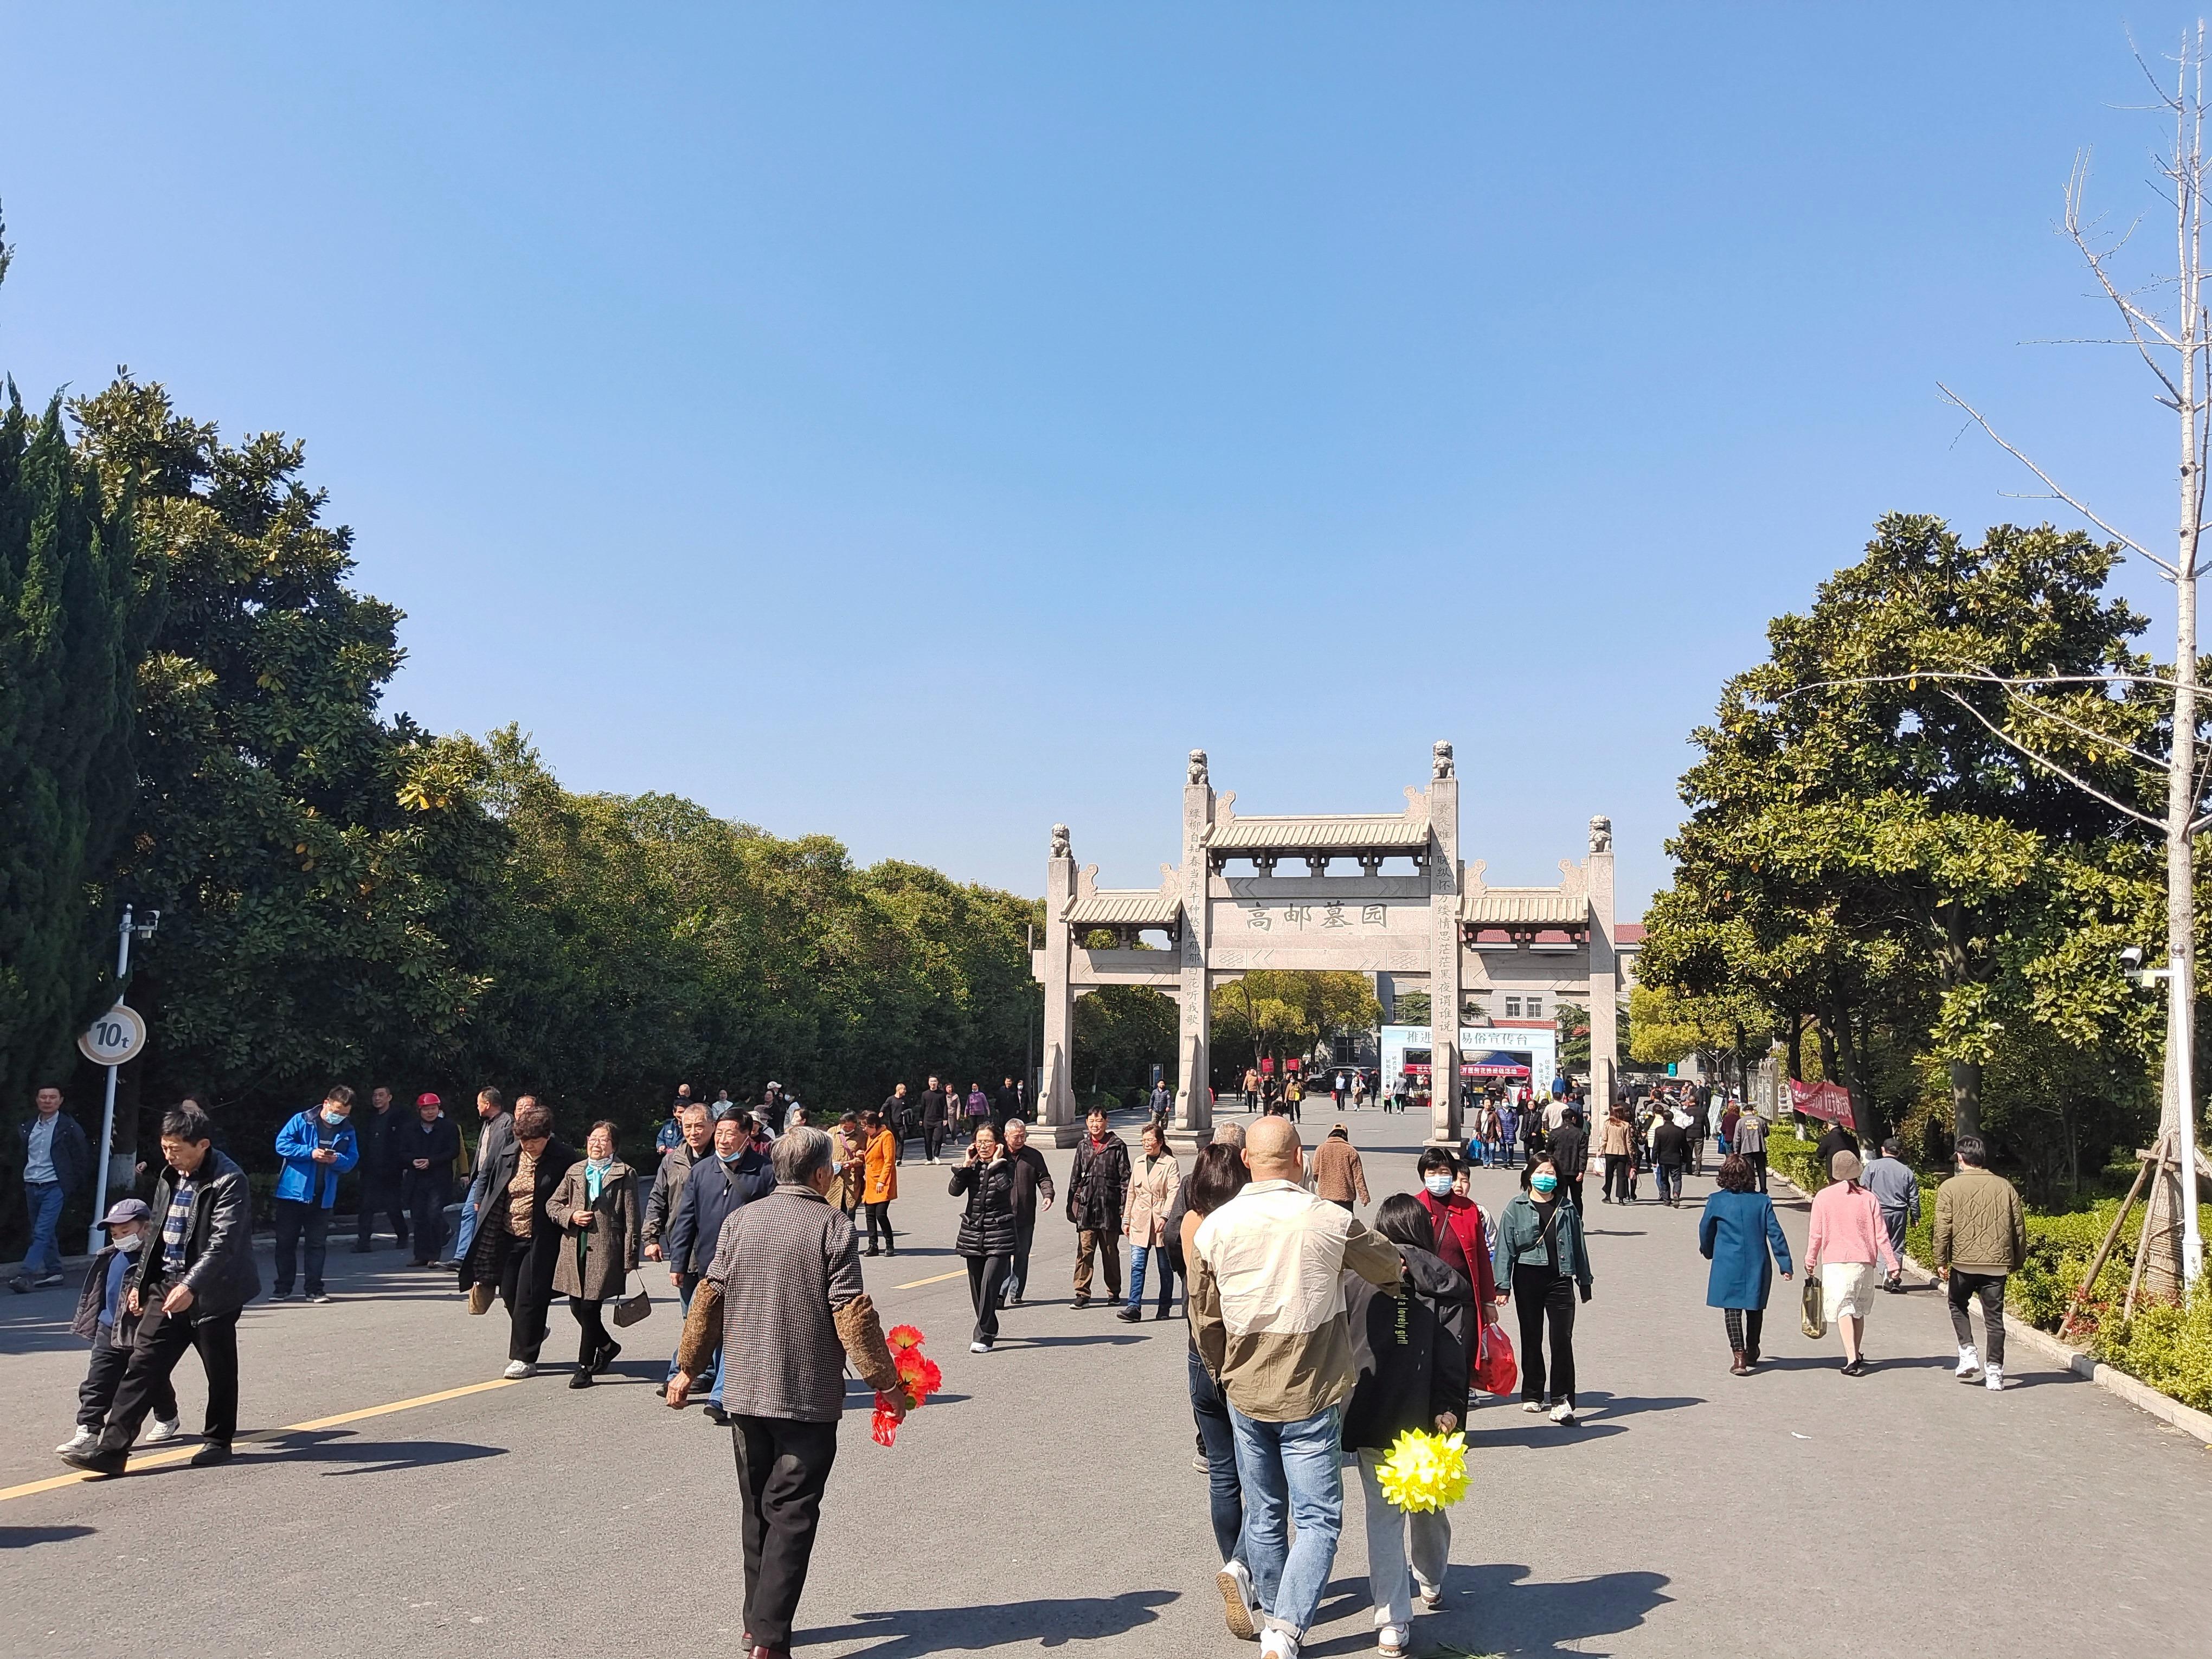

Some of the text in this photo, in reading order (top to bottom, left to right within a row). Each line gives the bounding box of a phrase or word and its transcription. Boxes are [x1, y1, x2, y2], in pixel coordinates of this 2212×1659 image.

[1246, 900, 1387, 931] 高邮墓园
[1394, 1308, 1409, 1329] lovely
